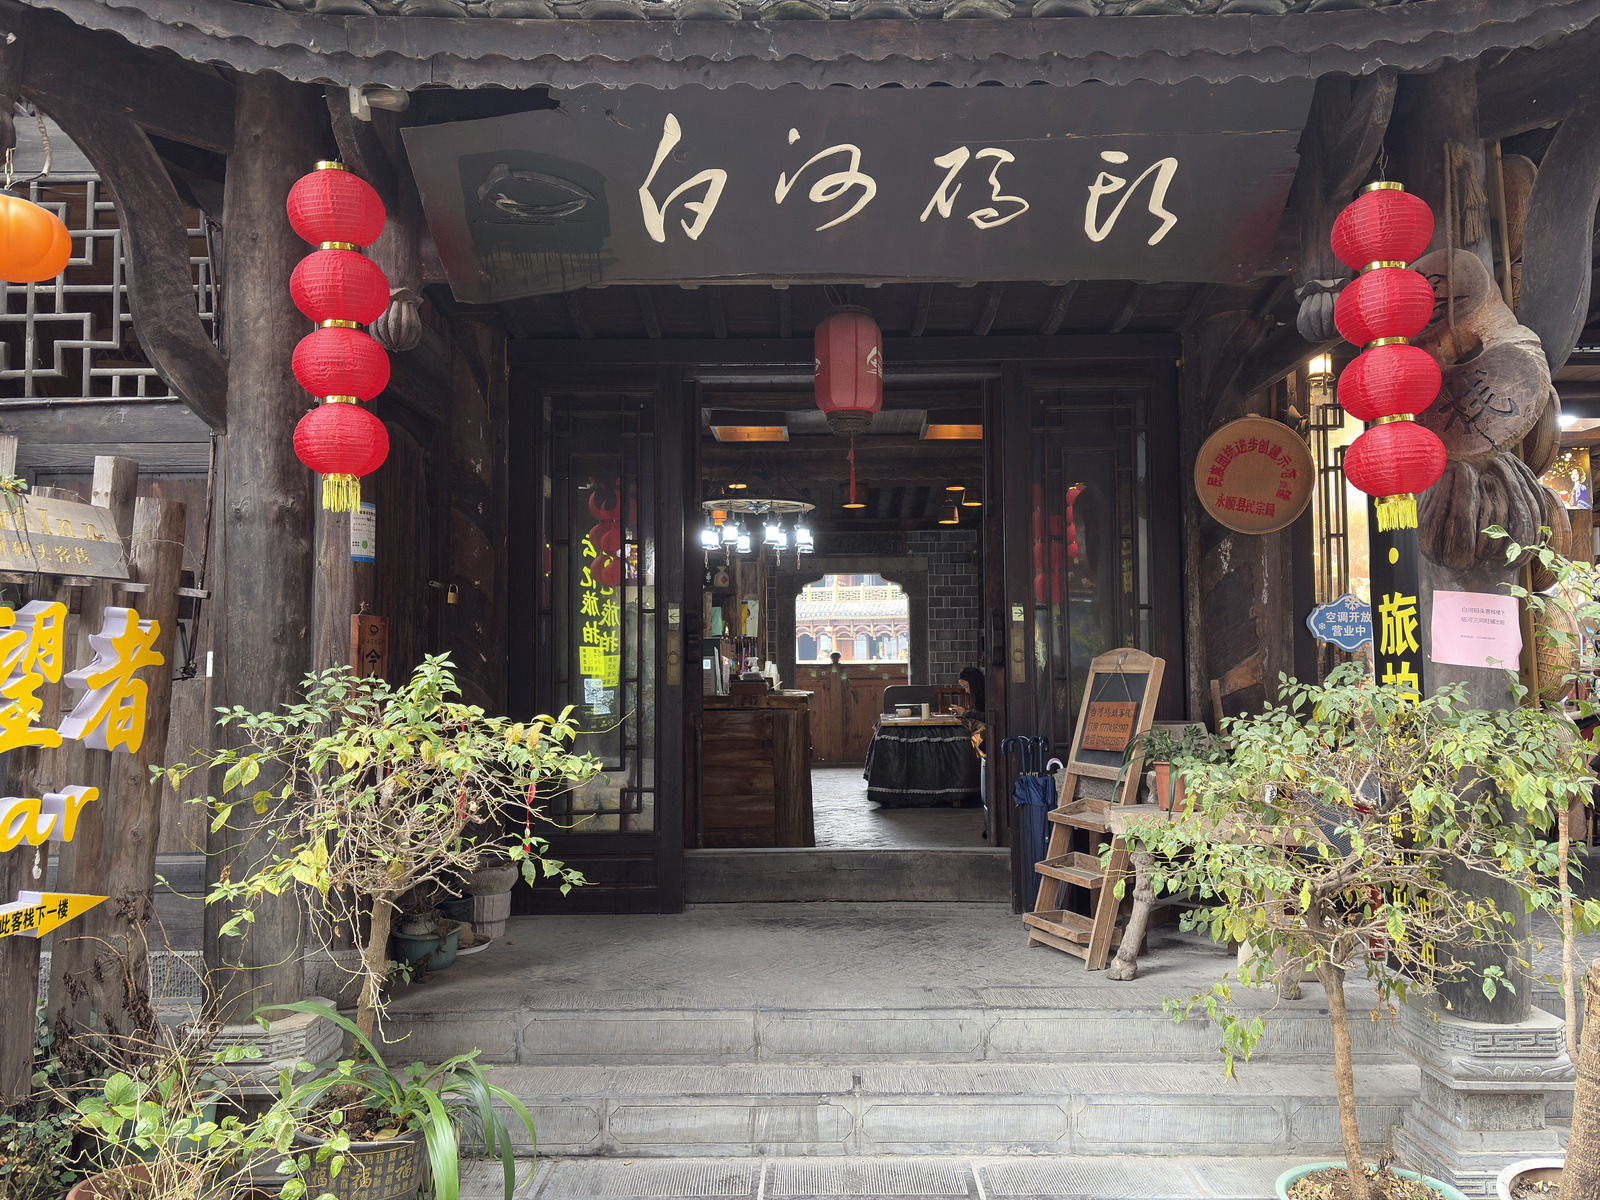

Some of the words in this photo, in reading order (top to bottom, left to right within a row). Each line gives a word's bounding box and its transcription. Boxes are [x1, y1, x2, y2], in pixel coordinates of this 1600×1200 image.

[1215, 493, 1276, 518] 永顺县民宗局
[0, 539, 92, 566] 码头客栈
[1326, 611, 1372, 623] 空调开放
[1331, 625, 1367, 637] 营业中
[0, 898, 69, 935] 此客栈下一楼
